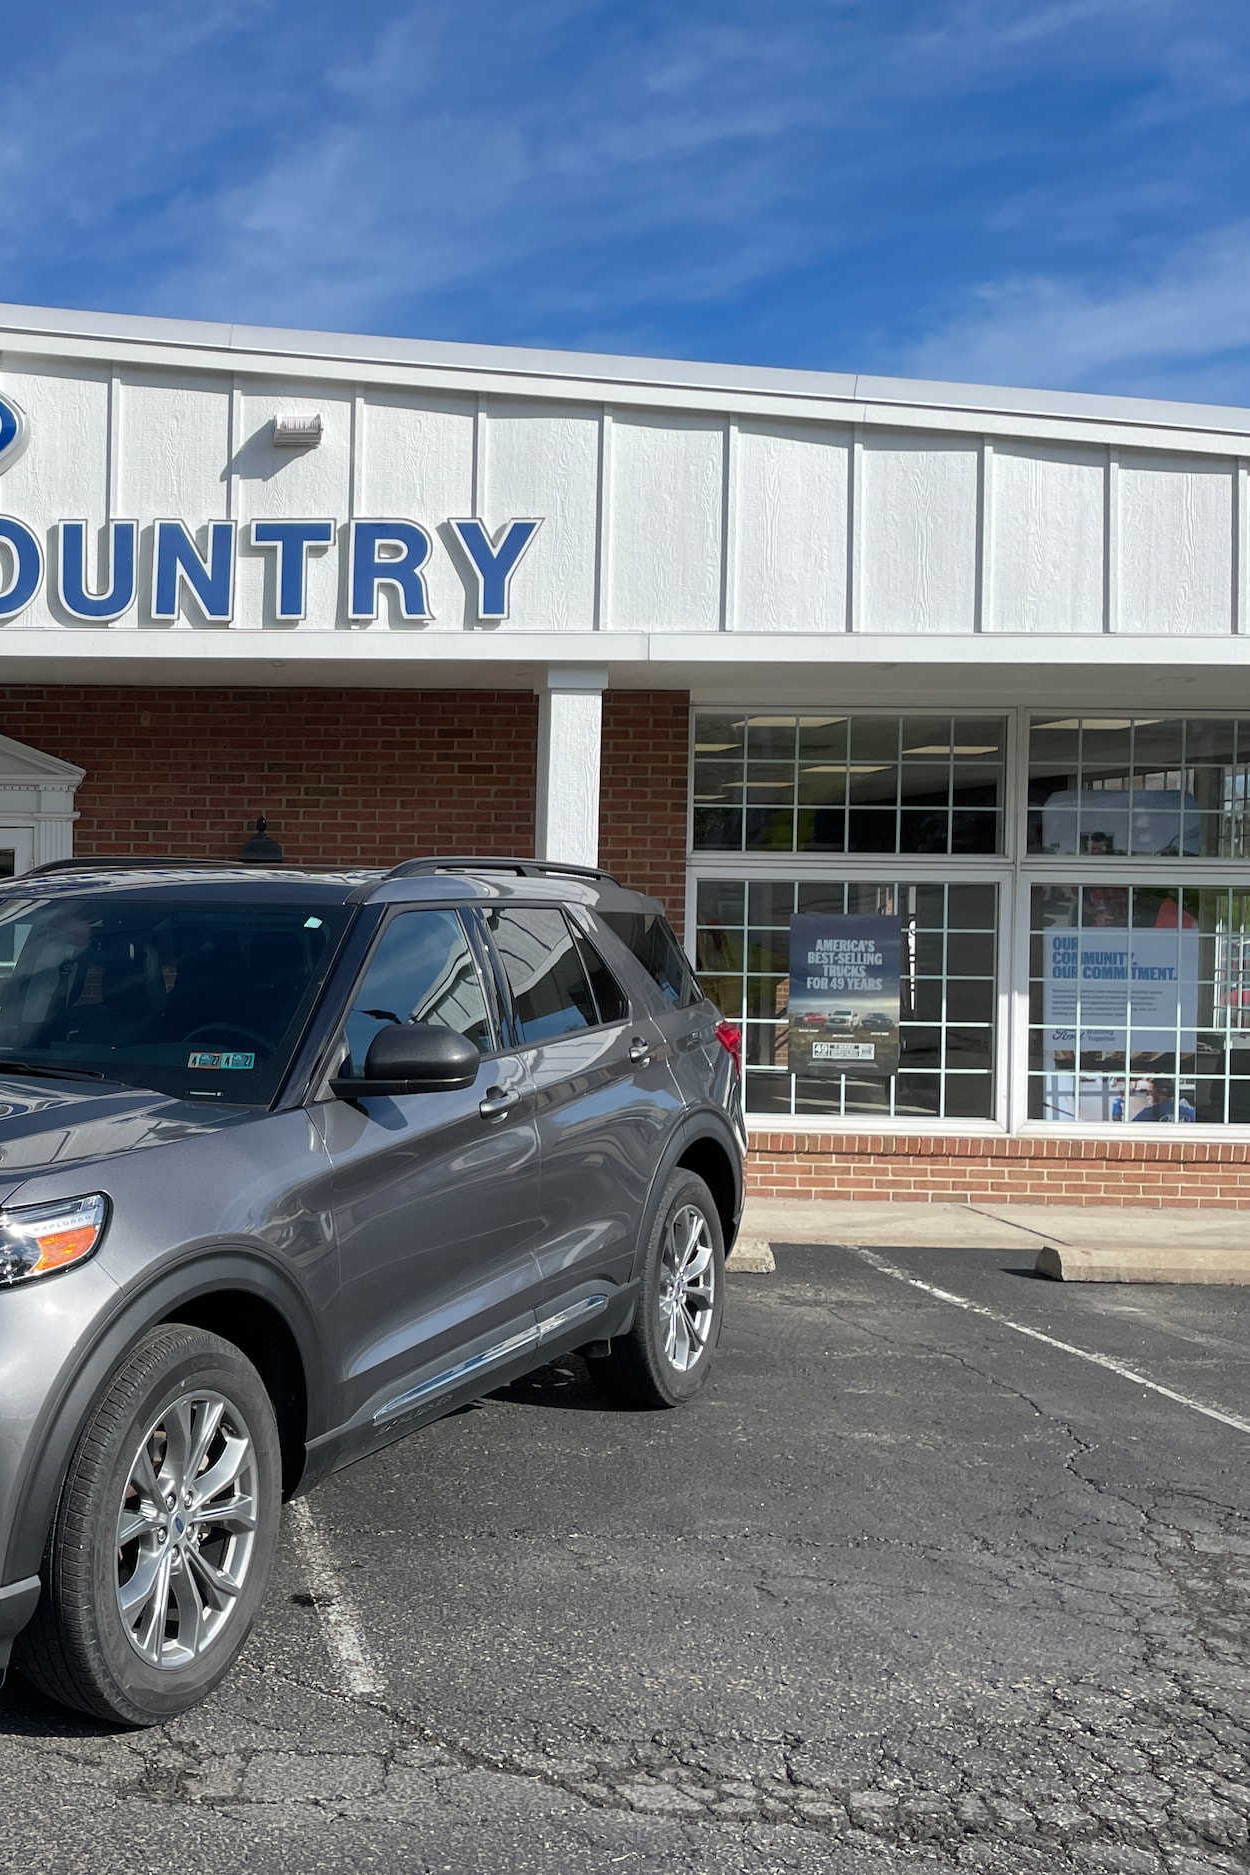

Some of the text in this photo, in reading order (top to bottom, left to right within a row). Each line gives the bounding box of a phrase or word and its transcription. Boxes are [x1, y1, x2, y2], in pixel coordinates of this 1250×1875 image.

[815, 939, 876, 952] AMERICA'S
[1052, 936, 1079, 950] OUR
[807, 951, 883, 965] BEST-SELLING
[823, 964, 867, 977] TRUCKS
[1052, 965, 1078, 979] OUR
[806, 976, 883, 990] FOR 49 YEARS
